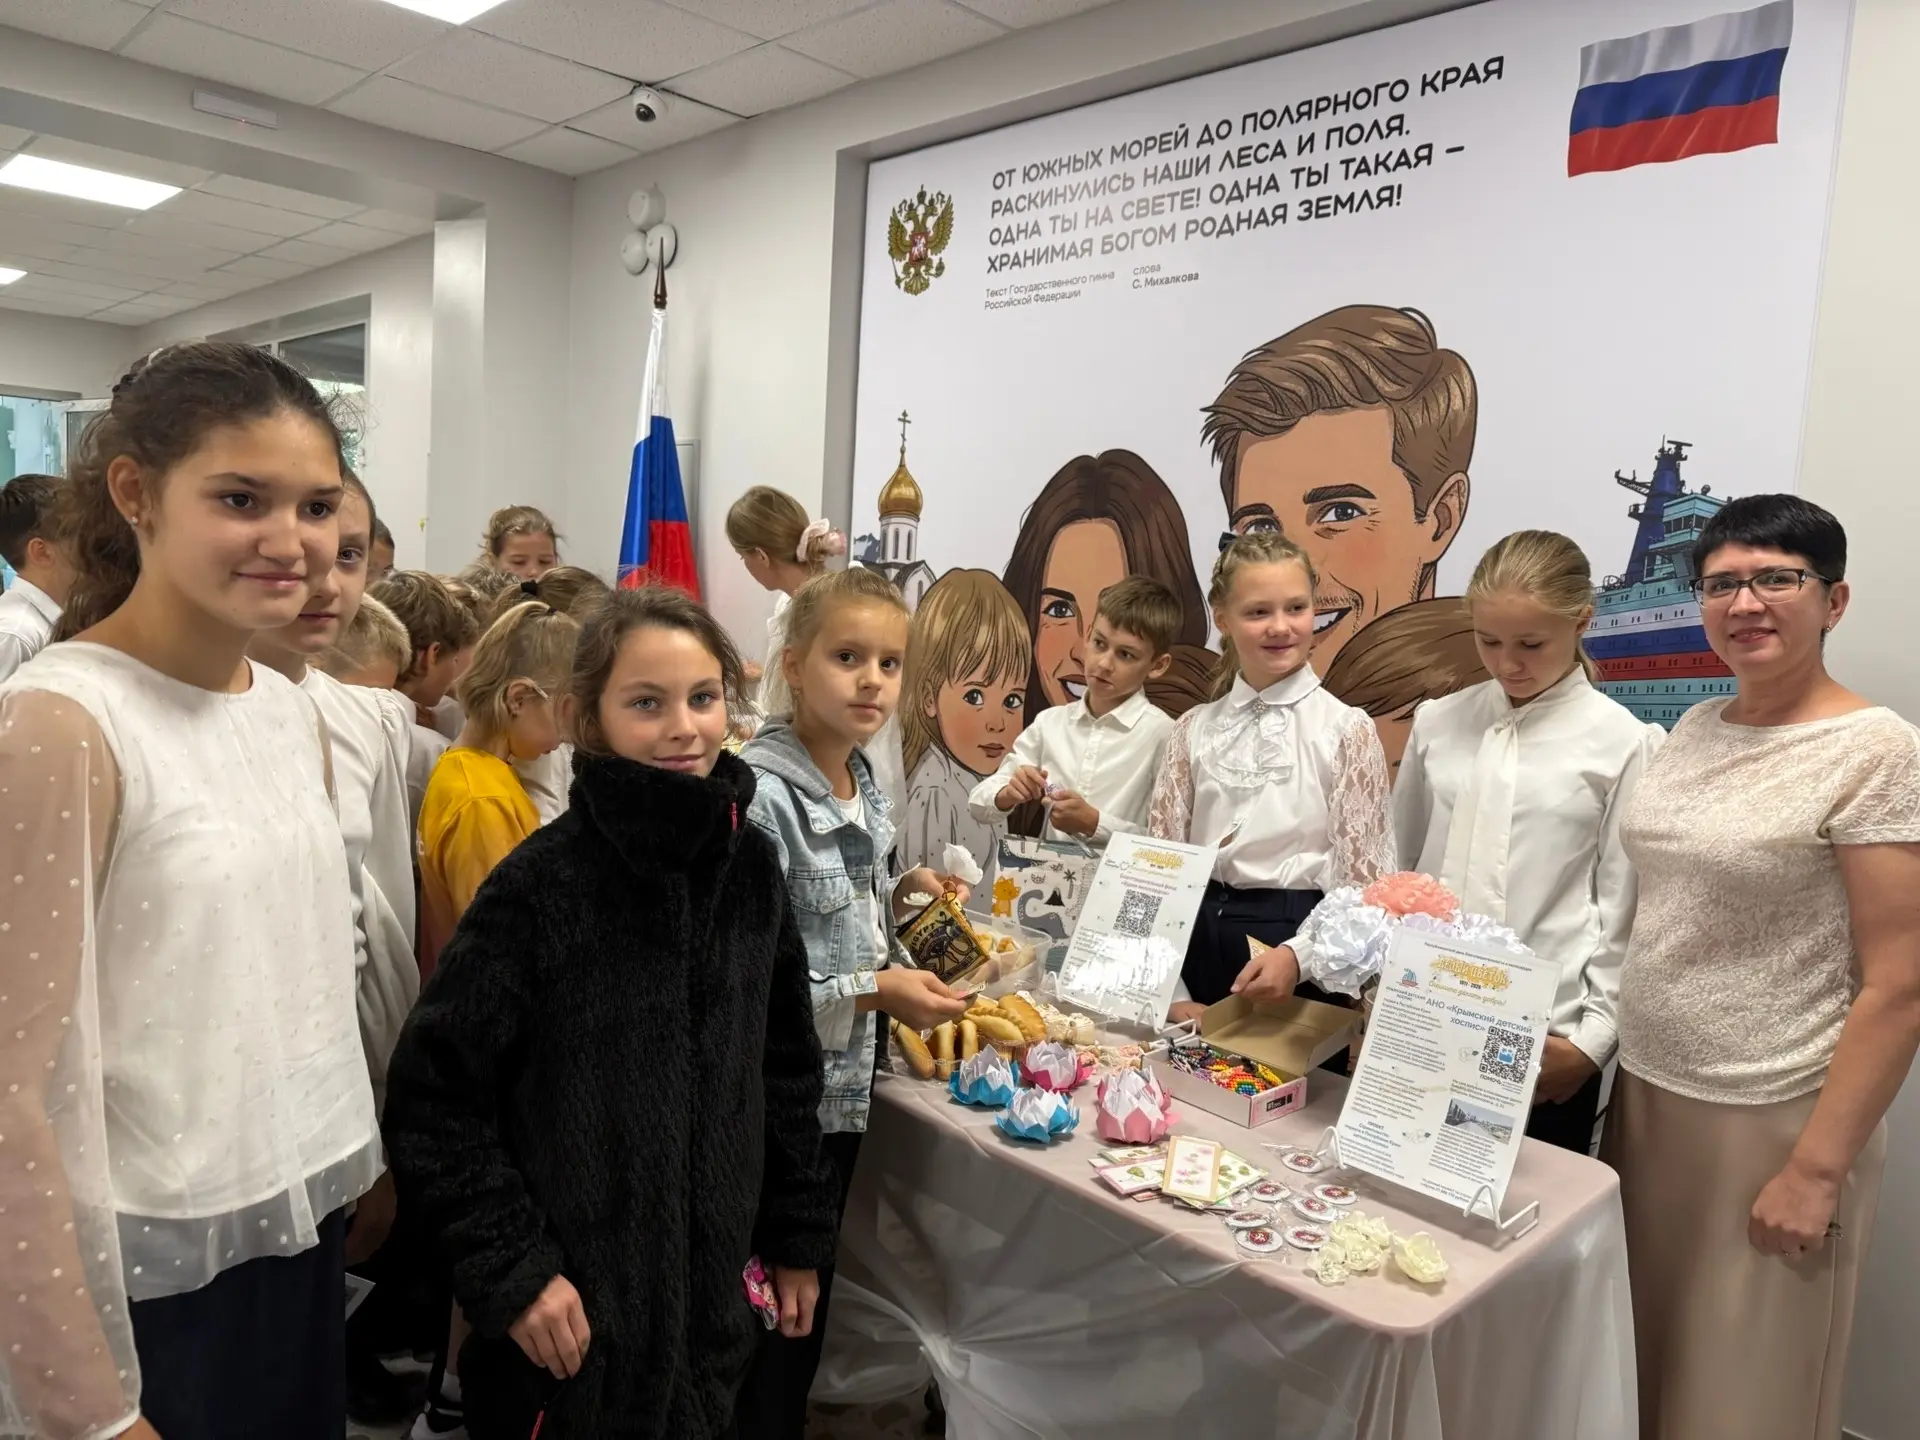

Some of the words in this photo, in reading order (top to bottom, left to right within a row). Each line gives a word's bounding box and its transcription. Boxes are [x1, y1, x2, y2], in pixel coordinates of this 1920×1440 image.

[992, 168, 1017, 191] ОТ
[1022, 148, 1103, 184] ЮЖНЫХ
[1110, 123, 1189, 165] МОРЕЙ
[1196, 119, 1233, 149] ДО
[1241, 79, 1410, 135] ПОЛЯРНОГО
[1420, 55, 1504, 97] КРАЯ
[991, 172, 1135, 219] РАСКИНУЛИСЬ
[1143, 154, 1211, 187] НАШИ
[1218, 139, 1287, 172] ЛЕСА
[1297, 131, 1315, 157] И
[1325, 113, 1410, 151] ПОЛЯ.
[989, 219, 1042, 248] ОДНА
[1048, 211, 1078, 235] ТЫ
[1084, 205, 1114, 229] НА
[1121, 187, 1201, 221] СВЕТЕ!
[1209, 173, 1280, 206] ОДНА
[1290, 162, 1329, 190] ТЫ
[1339, 143, 1433, 181] ТАКАЯ
[986, 238, 1093, 274] ХРАНИМАЯ
[1100, 222, 1177, 255] БОГОМ
[1185, 203, 1288, 240] РОДНАЯ
[1297, 183, 1402, 221] ЗЕМЛЯ!
[985, 286, 1008, 299] Текст
[1009, 275, 1088, 298] Государственного
[1088, 270, 1116, 284] гимна
[1132, 263, 1161, 277] слова
[1144, 271, 1199, 289] Михалкова
[984, 295, 1032, 311] Российской
[1033, 289, 1081, 304] Федерации
[1425, 998, 1446, 1009] АНО
[1446, 1003, 1495, 1023] «Крымский
[1495, 1018, 1533, 1034] детский
[1450, 1016, 1486, 1032] хоспис»
